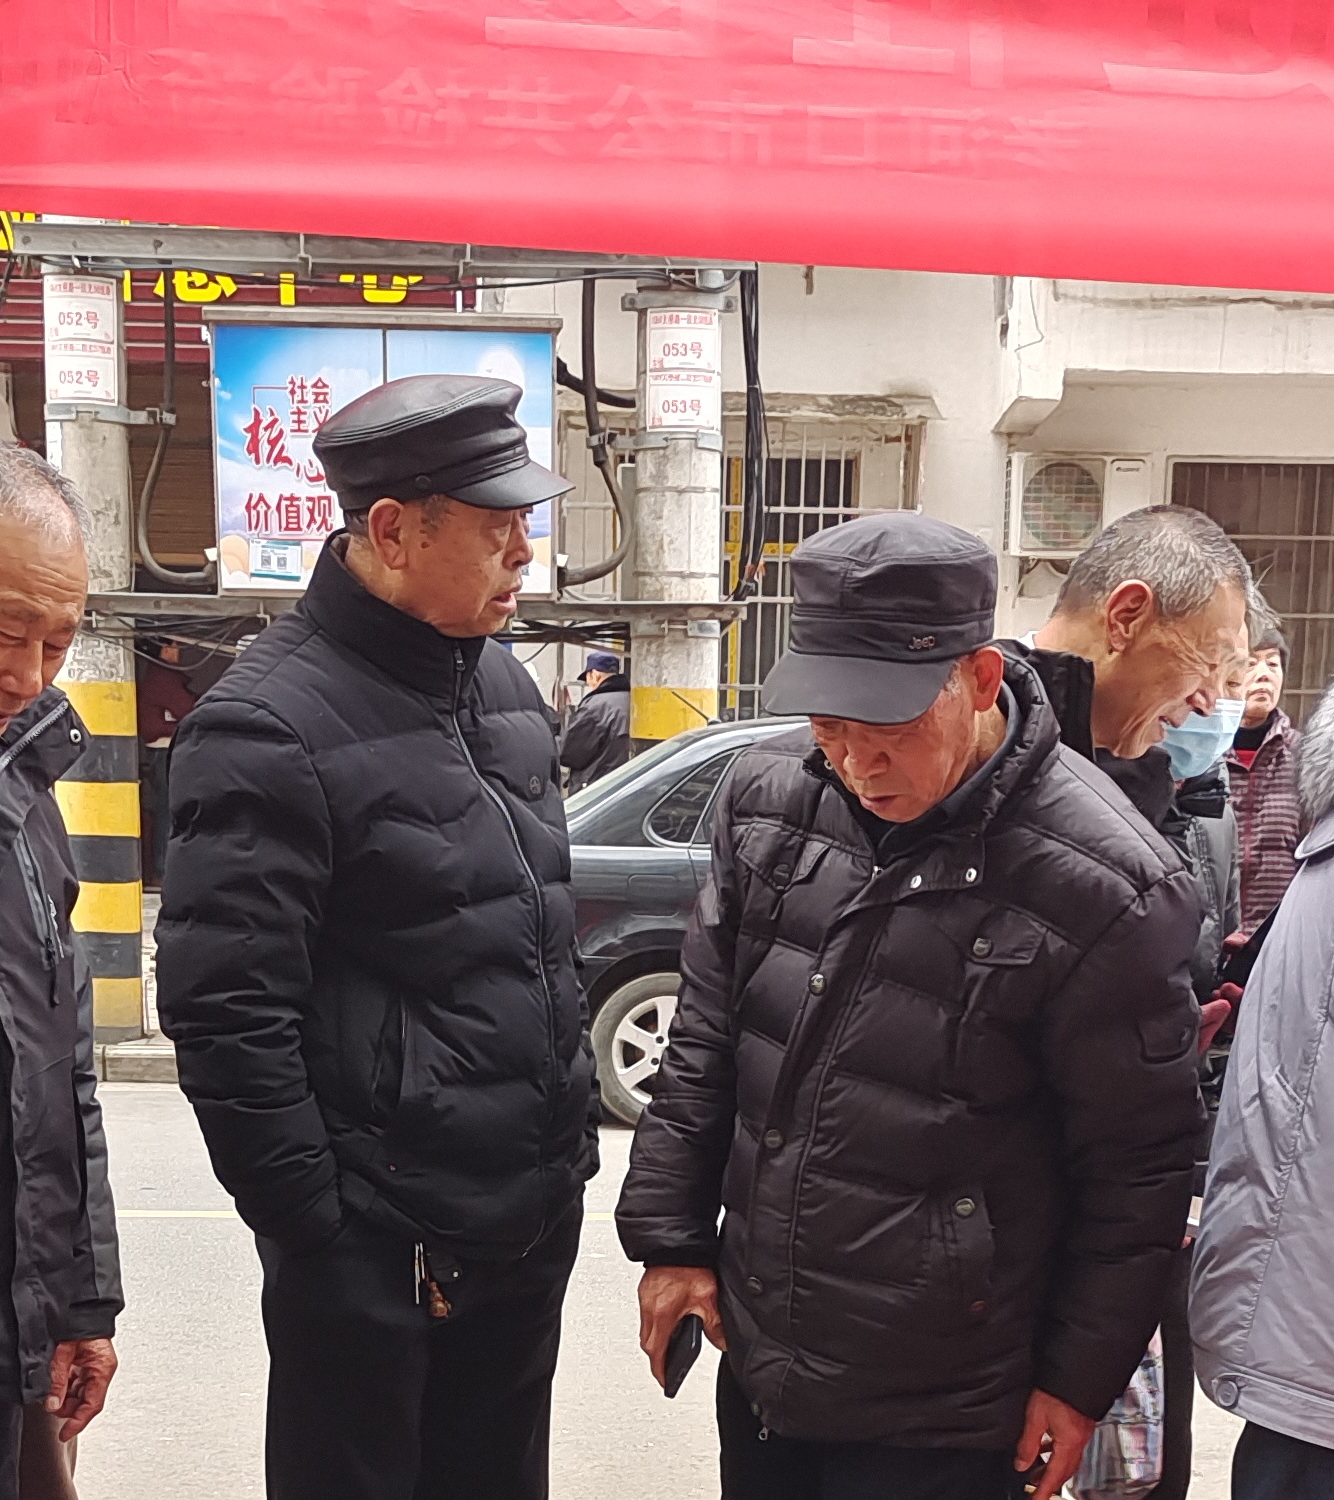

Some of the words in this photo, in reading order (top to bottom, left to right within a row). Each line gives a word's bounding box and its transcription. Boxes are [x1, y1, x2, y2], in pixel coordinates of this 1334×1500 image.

[58, 310, 100, 329] 052号
[662, 341, 703, 360] 053号
[58, 369, 101, 388] 052号
[287, 375, 331, 405] 社会
[661, 399, 702, 416] 053号
[288, 406, 330, 434] 主义
[244, 492, 335, 534] 价值观
[908, 635, 936, 650] Jeep
